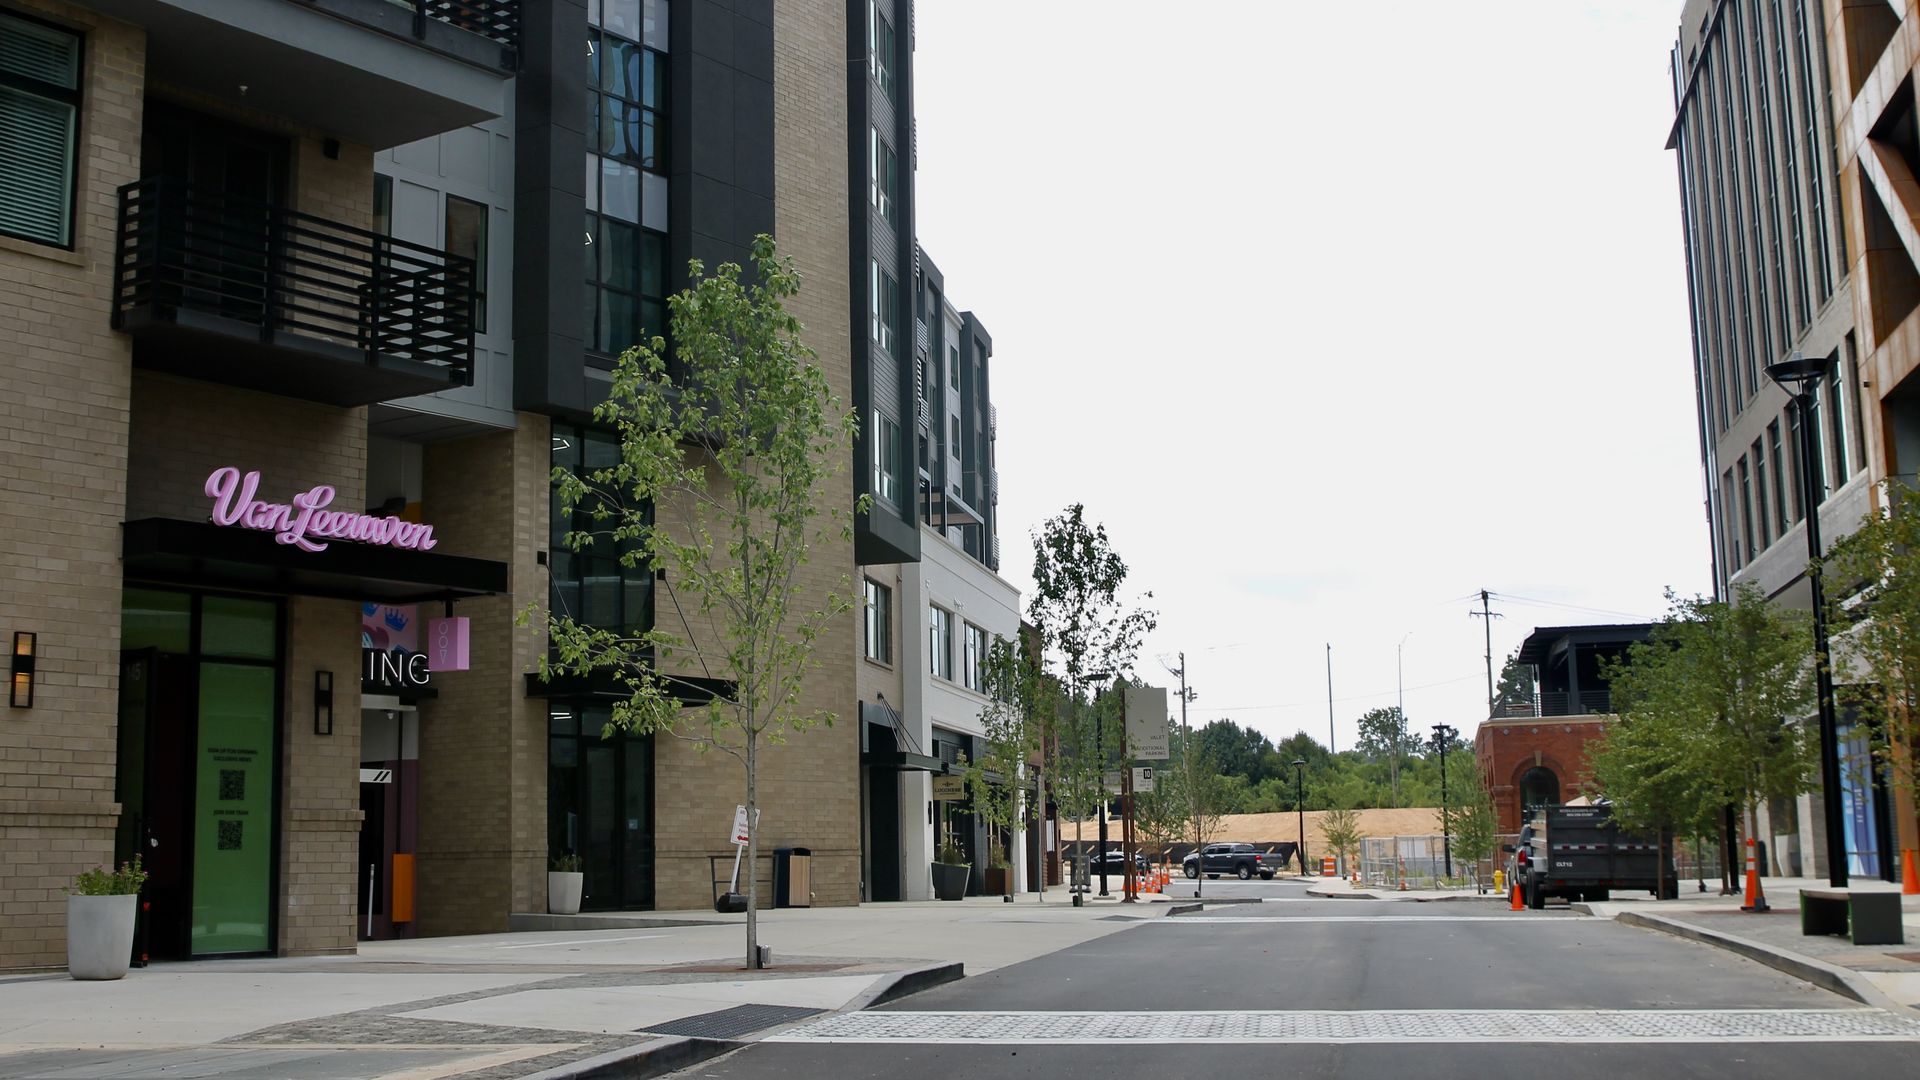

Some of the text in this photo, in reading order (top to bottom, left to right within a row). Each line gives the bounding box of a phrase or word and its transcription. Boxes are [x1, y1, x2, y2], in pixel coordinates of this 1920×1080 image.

[204, 466, 438, 552] Van Leeuwen
[361, 651, 431, 686] ING
